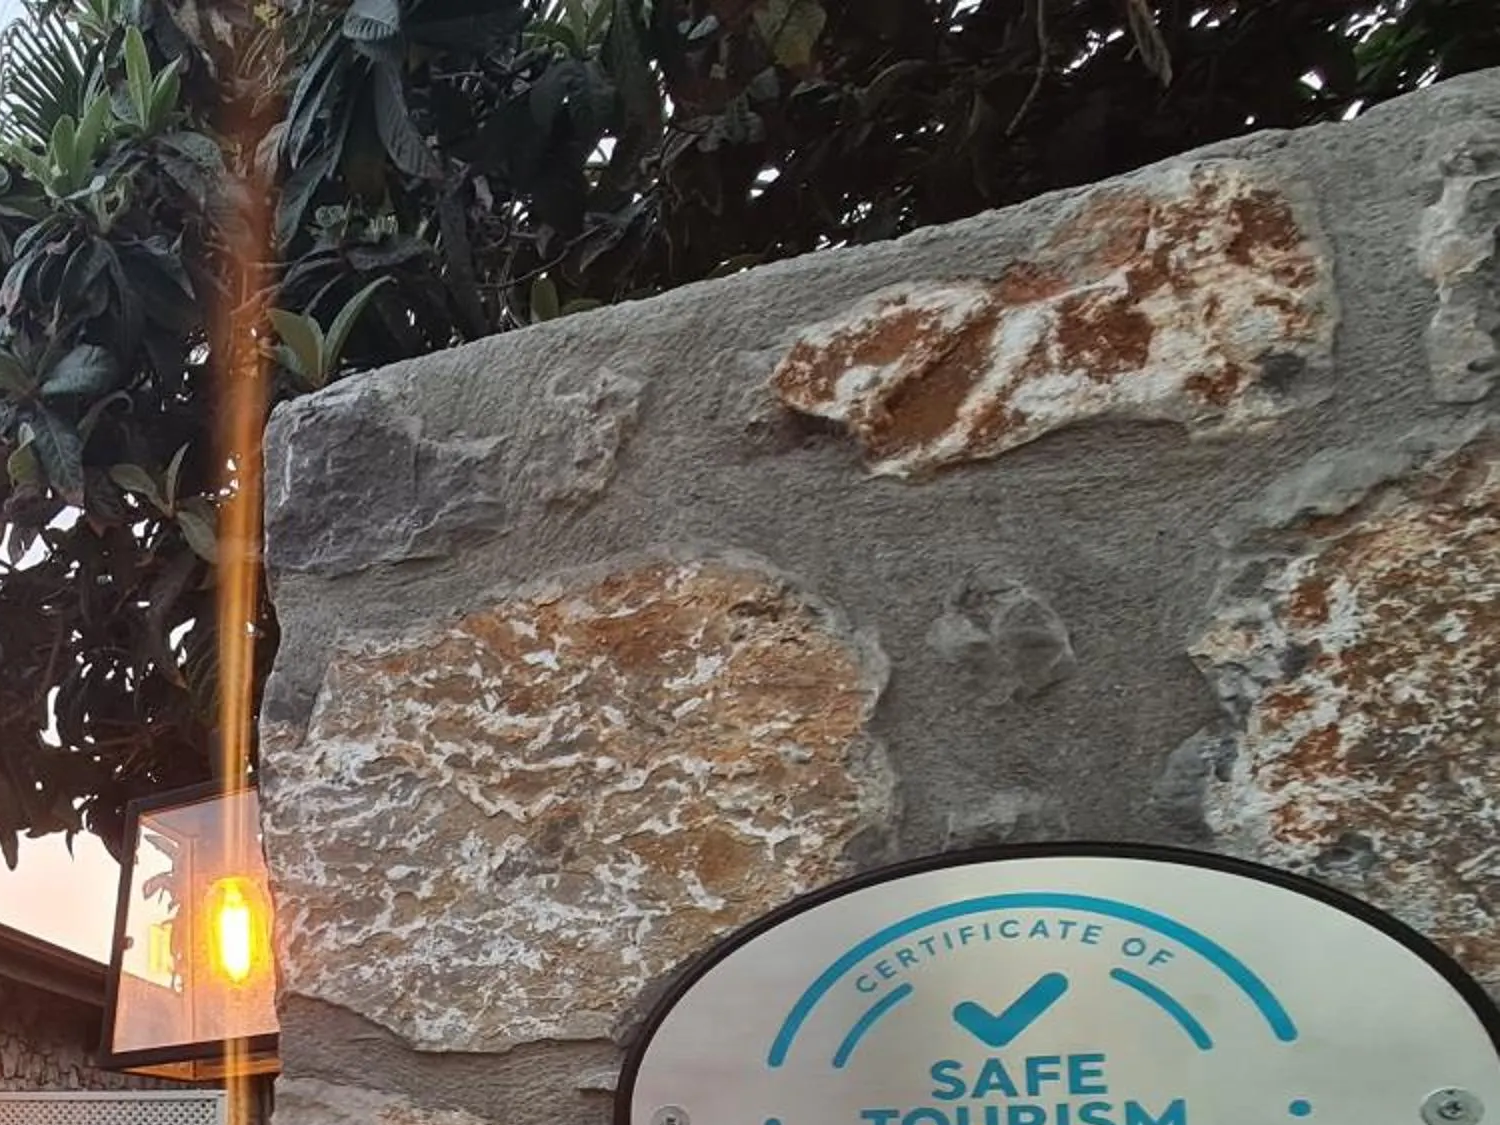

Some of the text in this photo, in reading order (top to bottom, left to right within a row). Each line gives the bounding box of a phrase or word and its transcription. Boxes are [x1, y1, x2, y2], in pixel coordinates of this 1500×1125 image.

[855, 919, 1176, 994] CERTIFICATE OF
[930, 1053, 1108, 1100] SAFE
